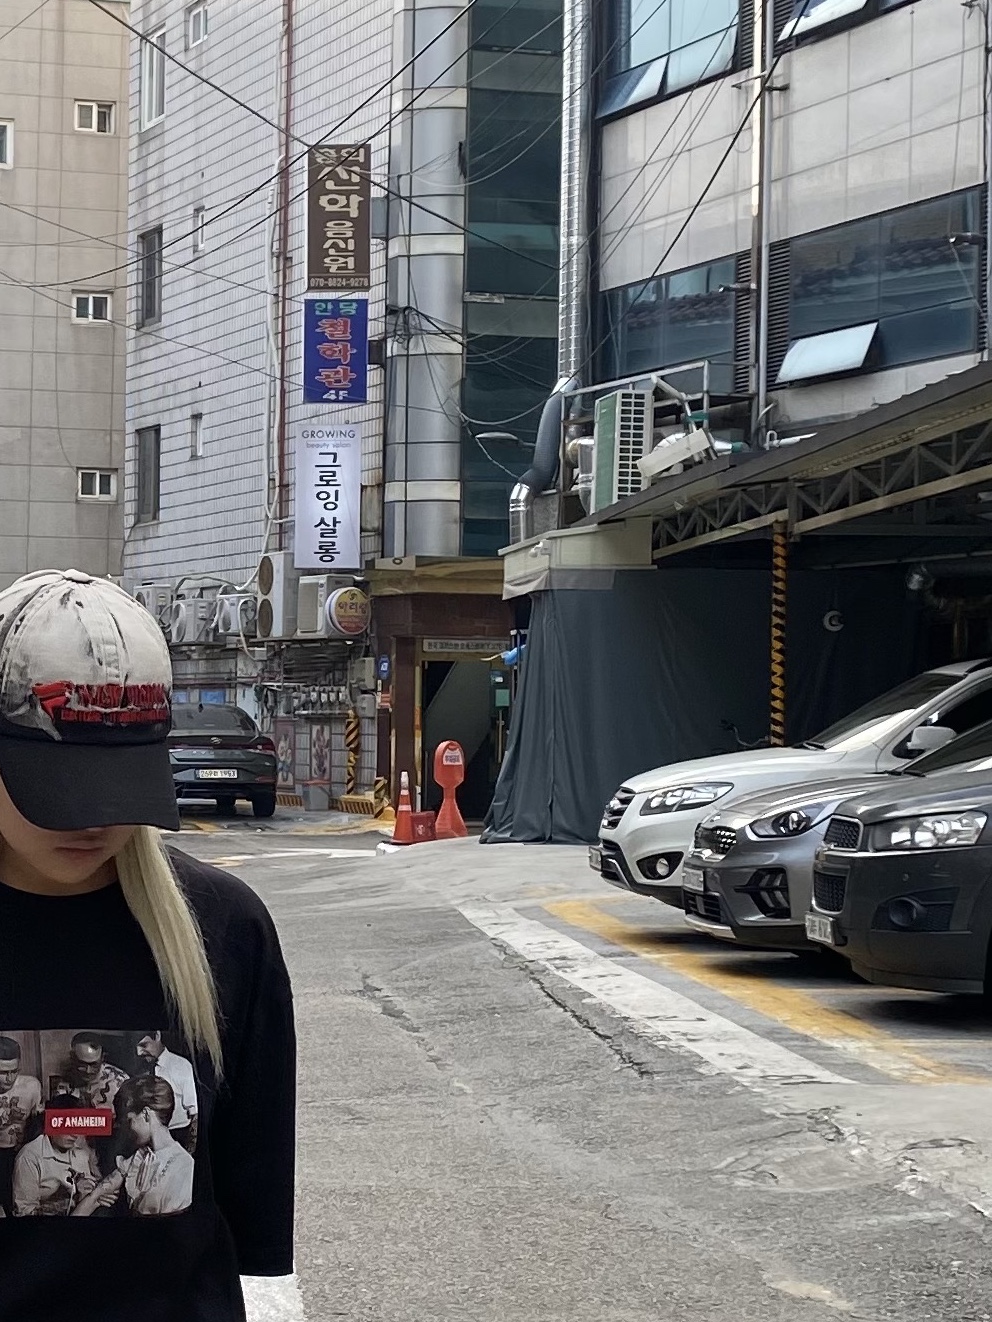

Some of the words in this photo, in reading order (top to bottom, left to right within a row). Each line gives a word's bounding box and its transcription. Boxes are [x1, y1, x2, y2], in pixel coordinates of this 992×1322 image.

[322, 390, 349, 400] 4F
[301, 430, 356, 439] GROWING
[314, 452, 342, 511] 그로잉
[313, 516, 342, 563] 살롱
[51, 1117, 64, 1127] OF
[65, 1116, 106, 1128] ANAHEIM
